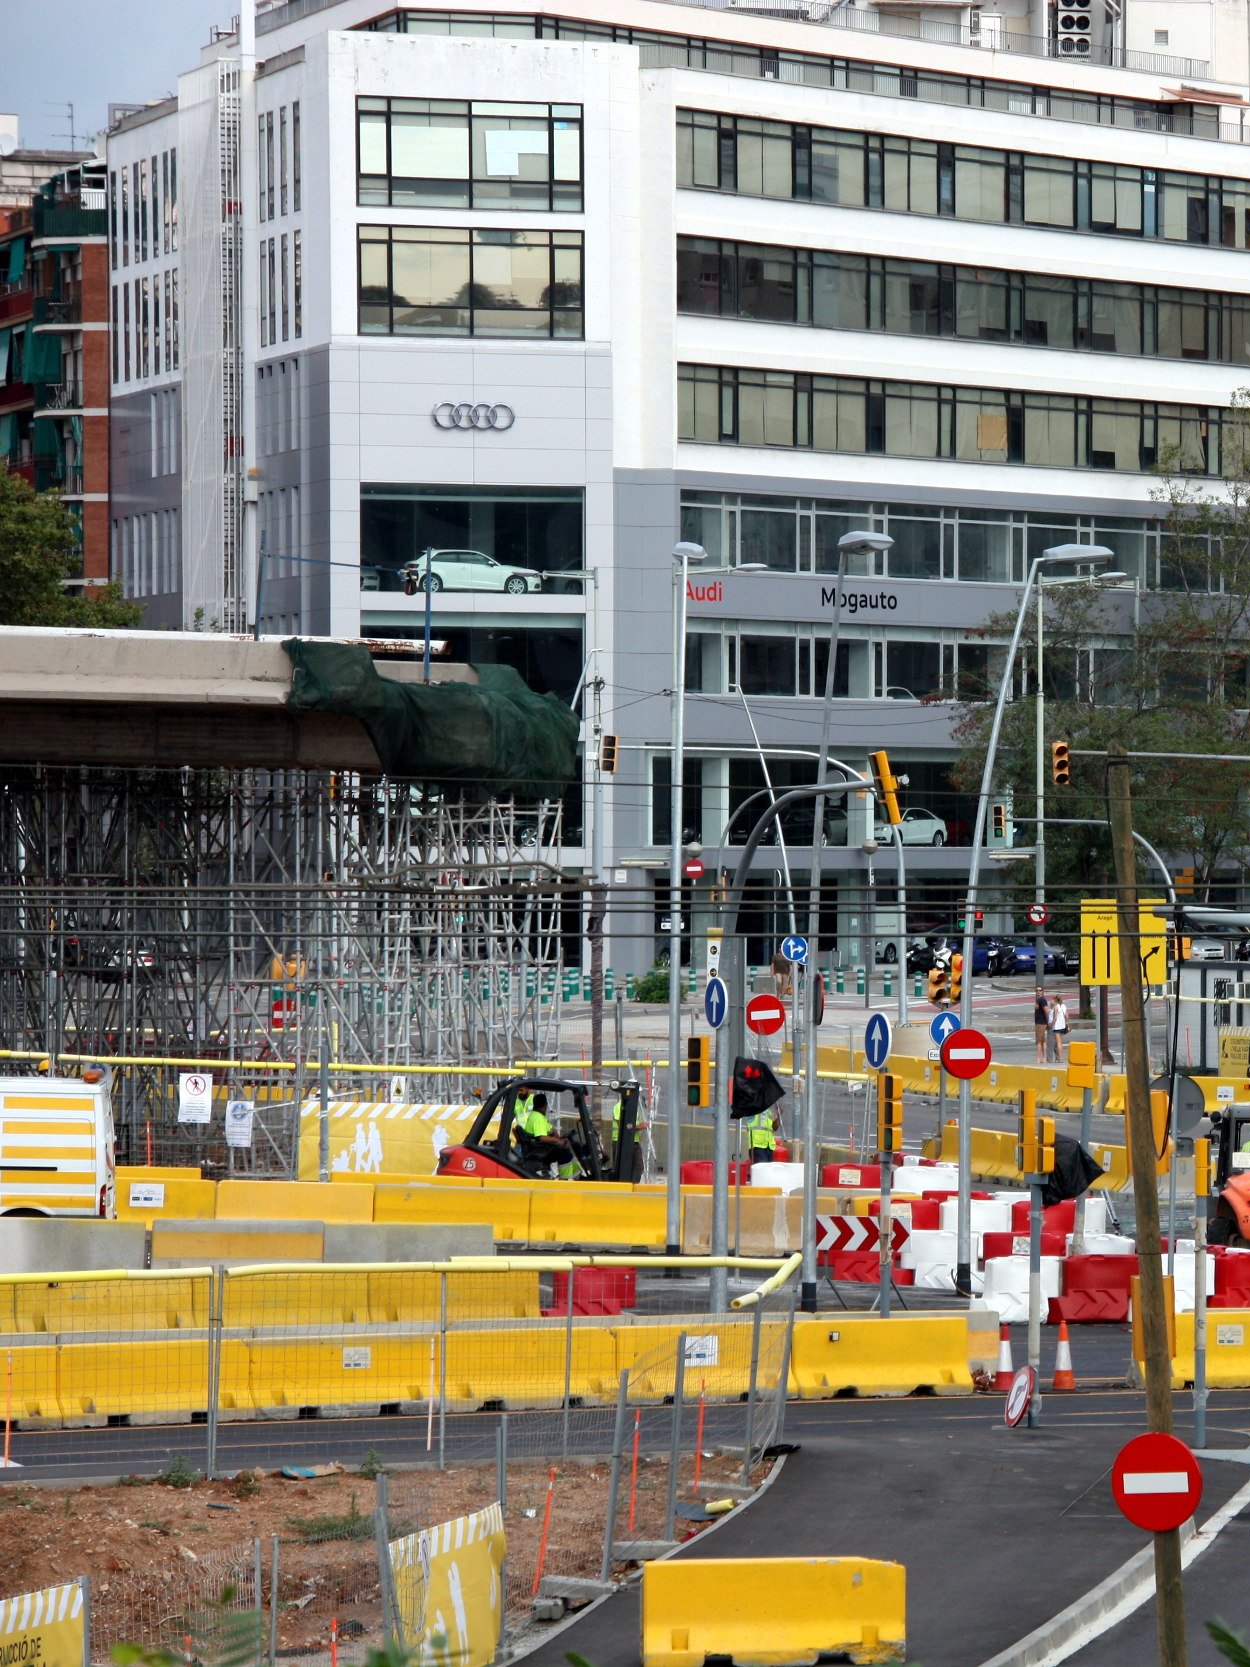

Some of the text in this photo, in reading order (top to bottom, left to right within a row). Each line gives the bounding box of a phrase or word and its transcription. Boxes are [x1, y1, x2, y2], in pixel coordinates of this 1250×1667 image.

[686, 581, 722, 601] Audi
[821, 587, 898, 613] Mogauto
[464, 1159, 475, 1169] 25
[31, 1637, 42, 1660] DE
